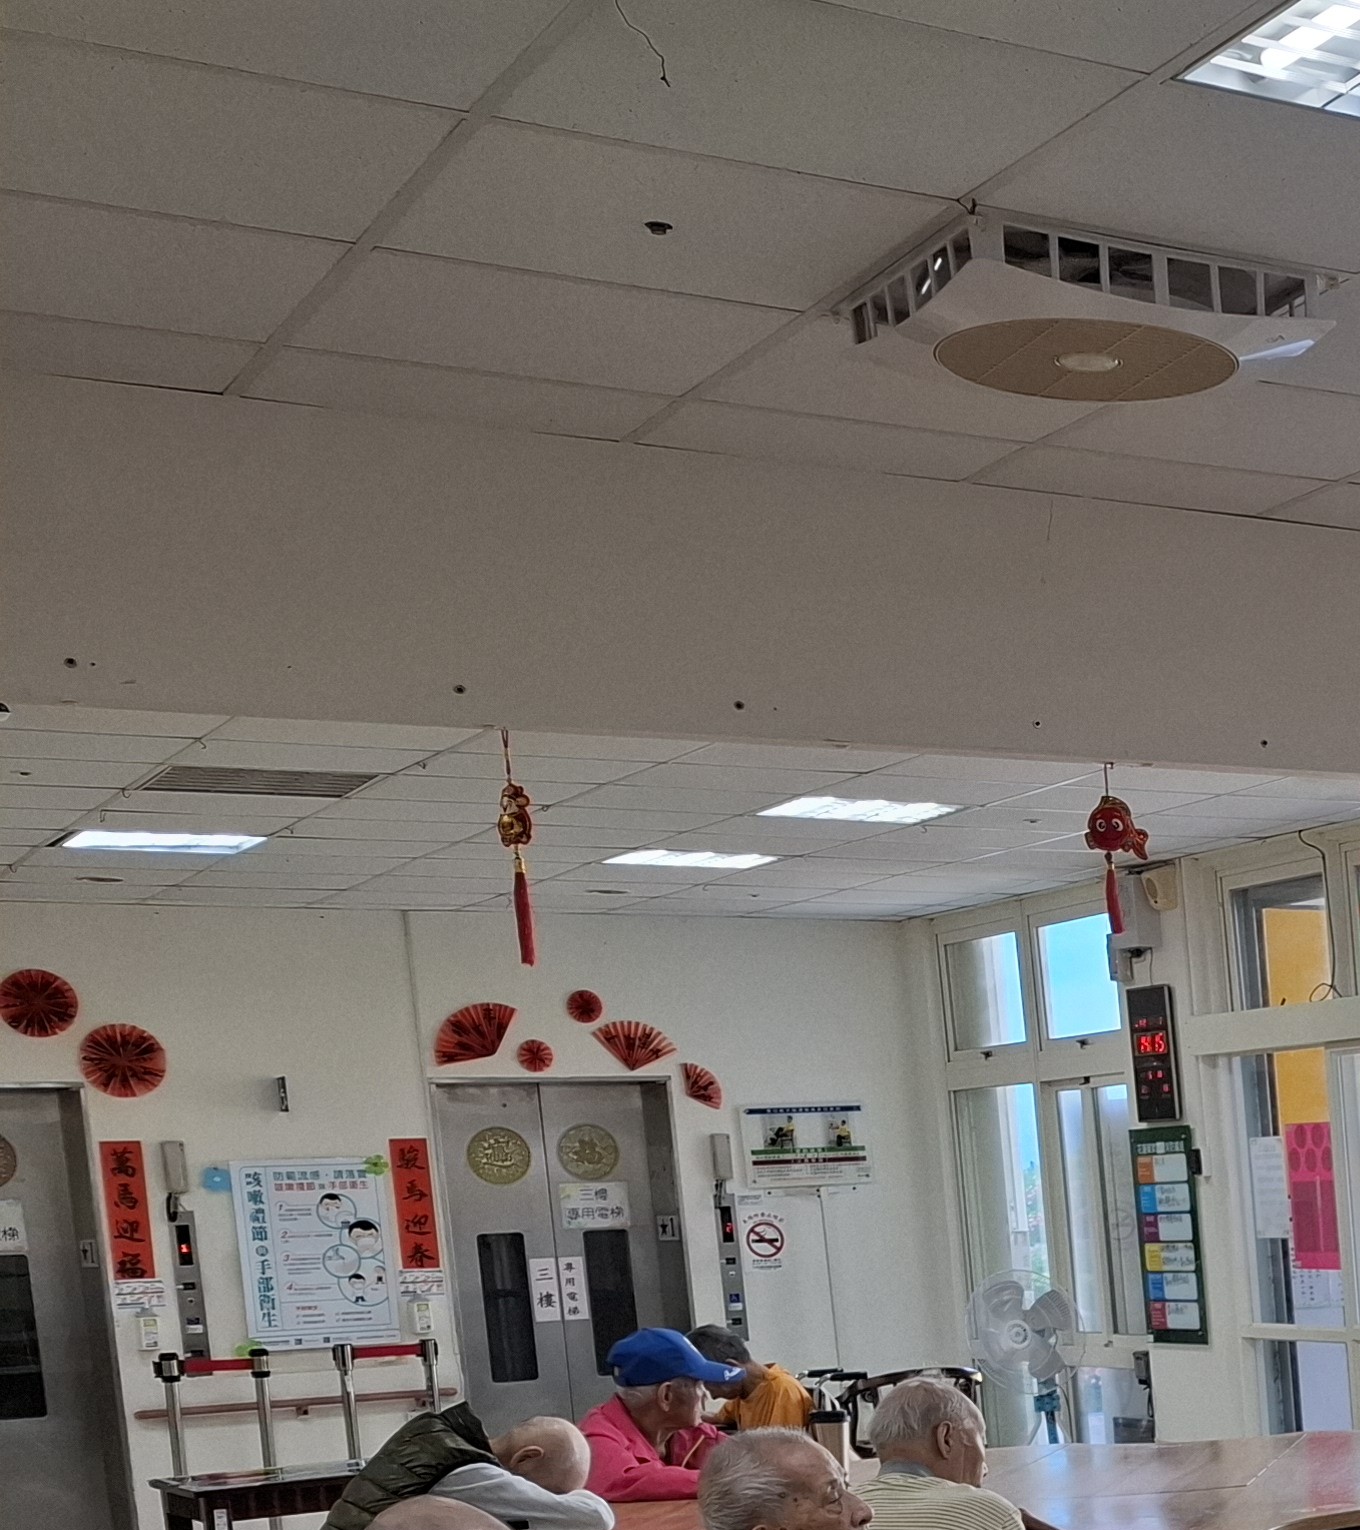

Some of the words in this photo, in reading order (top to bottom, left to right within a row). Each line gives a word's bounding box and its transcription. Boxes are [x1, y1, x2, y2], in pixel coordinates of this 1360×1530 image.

[110, 1147, 147, 1279] 萬馬迎福
[396, 1145, 436, 1268] 駿馬迎春
[535, 1267, 557, 1309] 三樓
[563, 1261, 580, 1316] 專用電梯
